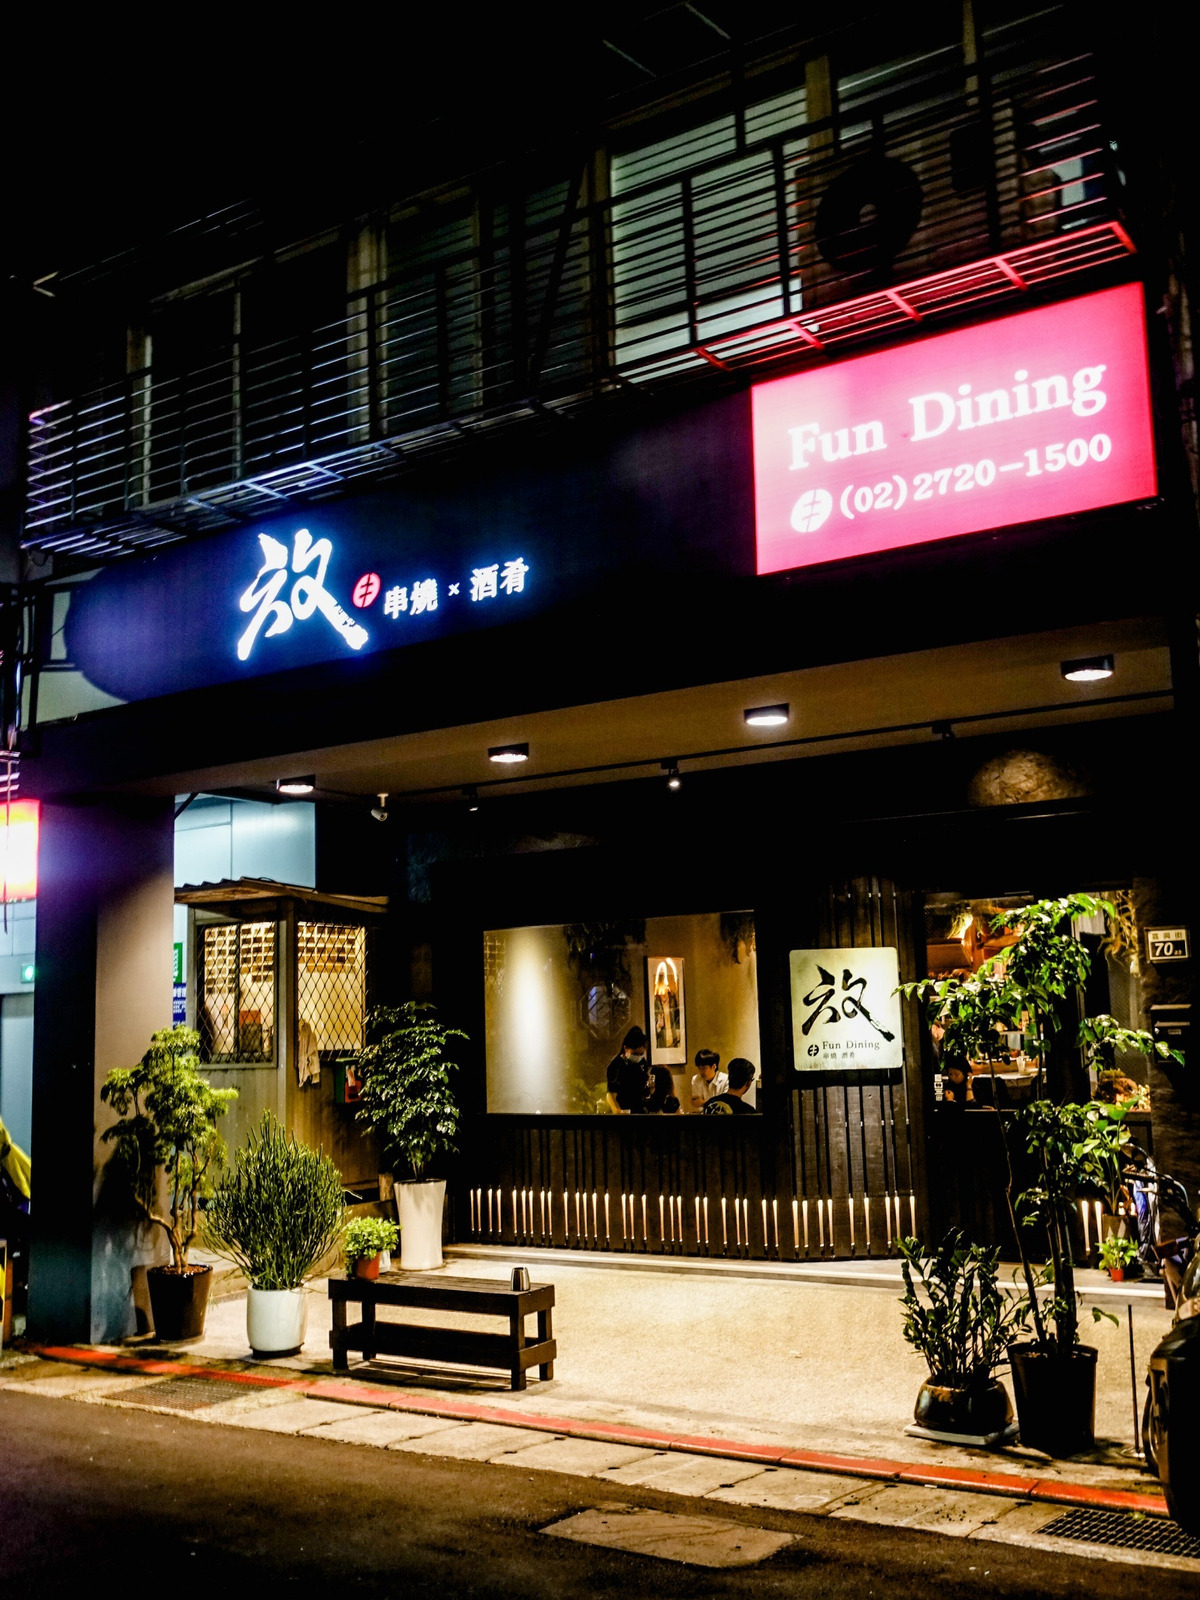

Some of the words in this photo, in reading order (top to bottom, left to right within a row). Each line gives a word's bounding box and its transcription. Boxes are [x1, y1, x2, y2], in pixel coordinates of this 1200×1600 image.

[787, 419, 888, 471] Fun
[908, 364, 1108, 442] Dining
[237, 528, 369, 661] 放
[1154, 941, 1174, 957] 70
[801, 963, 896, 1043] 放
[822, 1040, 841, 1050] Fun
[846, 1039, 880, 1051] Dining
